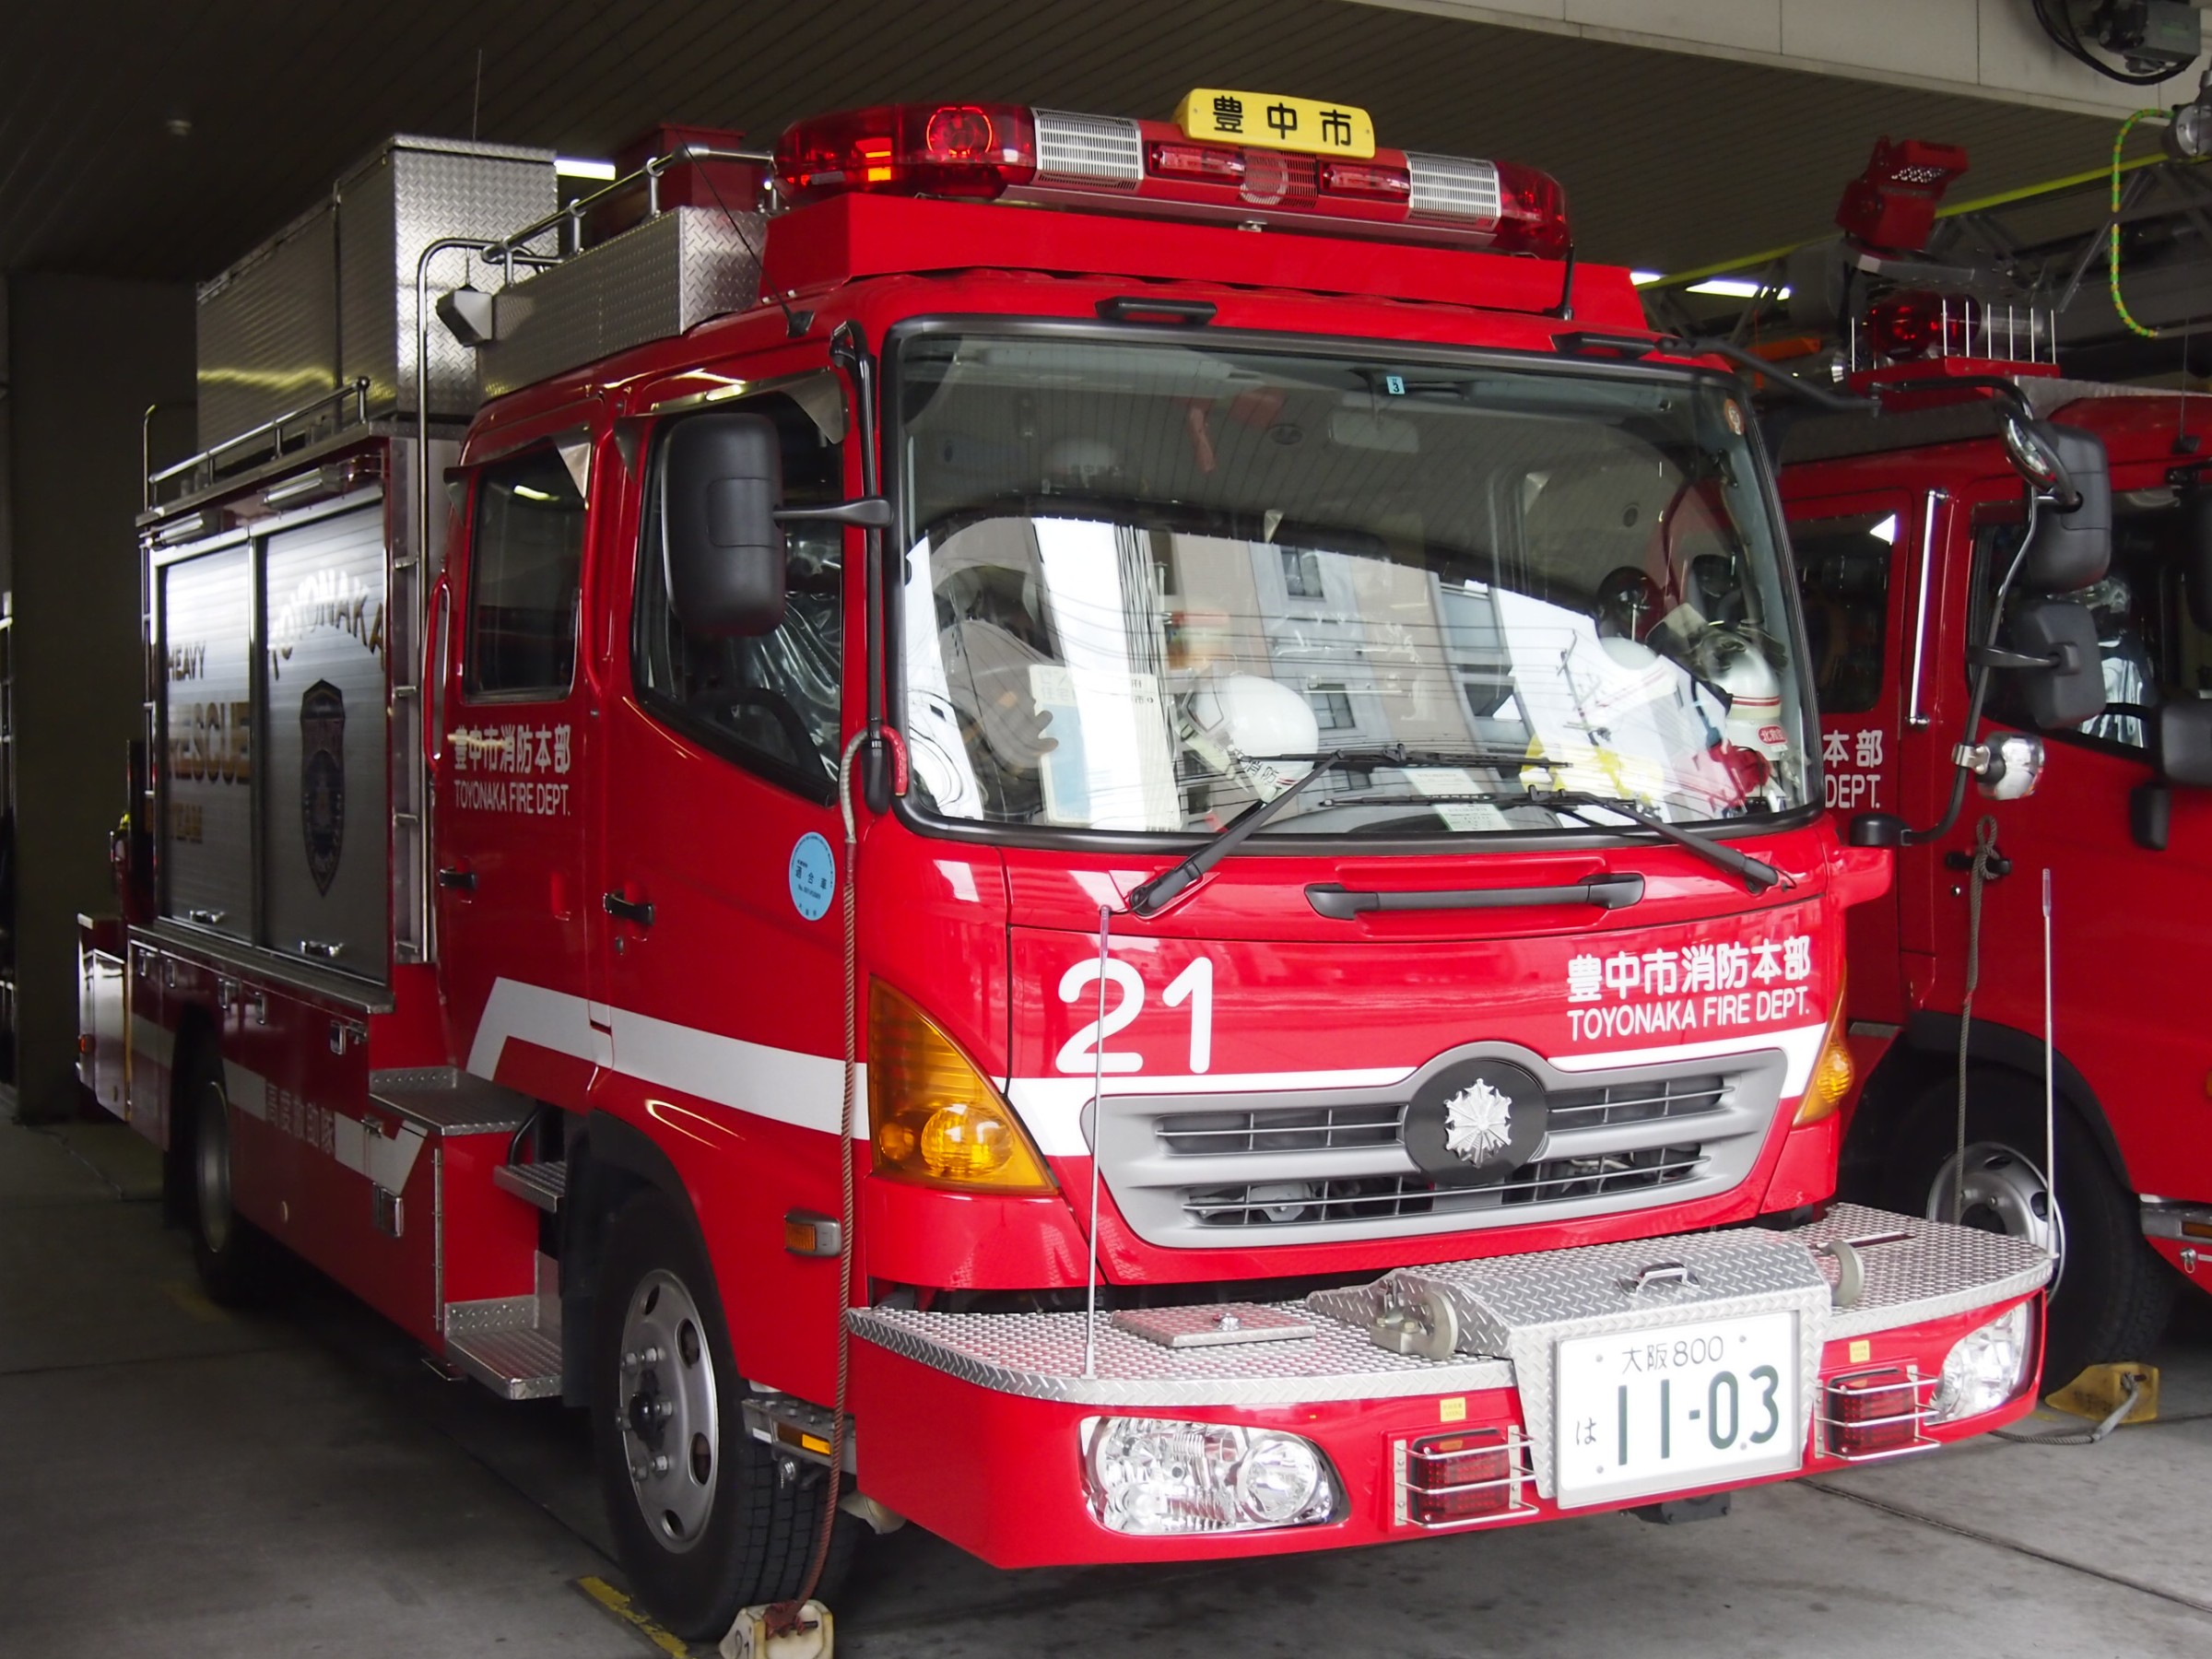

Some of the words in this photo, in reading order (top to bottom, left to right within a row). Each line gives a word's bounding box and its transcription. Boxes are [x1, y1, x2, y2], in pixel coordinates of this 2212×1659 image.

[1212, 95, 1352, 147] 豊中市
[267, 569, 385, 681] TOYONAKA
[168, 641, 206, 682] HEAVY
[453, 723, 571, 774] 豊中市消防本部
[1822, 729, 1883, 768] 本部
[454, 780, 507, 811] TOYONAKA
[509, 782, 535, 814] FIRE
[536, 783, 571, 817] DEPT.
[1825, 774, 1881, 808] DEPT.
[1567, 935, 1811, 1003] 豊中市消防本部
[1055, 956, 1213, 1075] 21
[1567, 999, 1697, 1041] TOYONAKA
[1703, 993, 1750, 1028] FIRE
[1756, 985, 1810, 1022] DEPT.
[1576, 1418, 1597, 1445] は
[1618, 1364, 1780, 1465] 11-03
